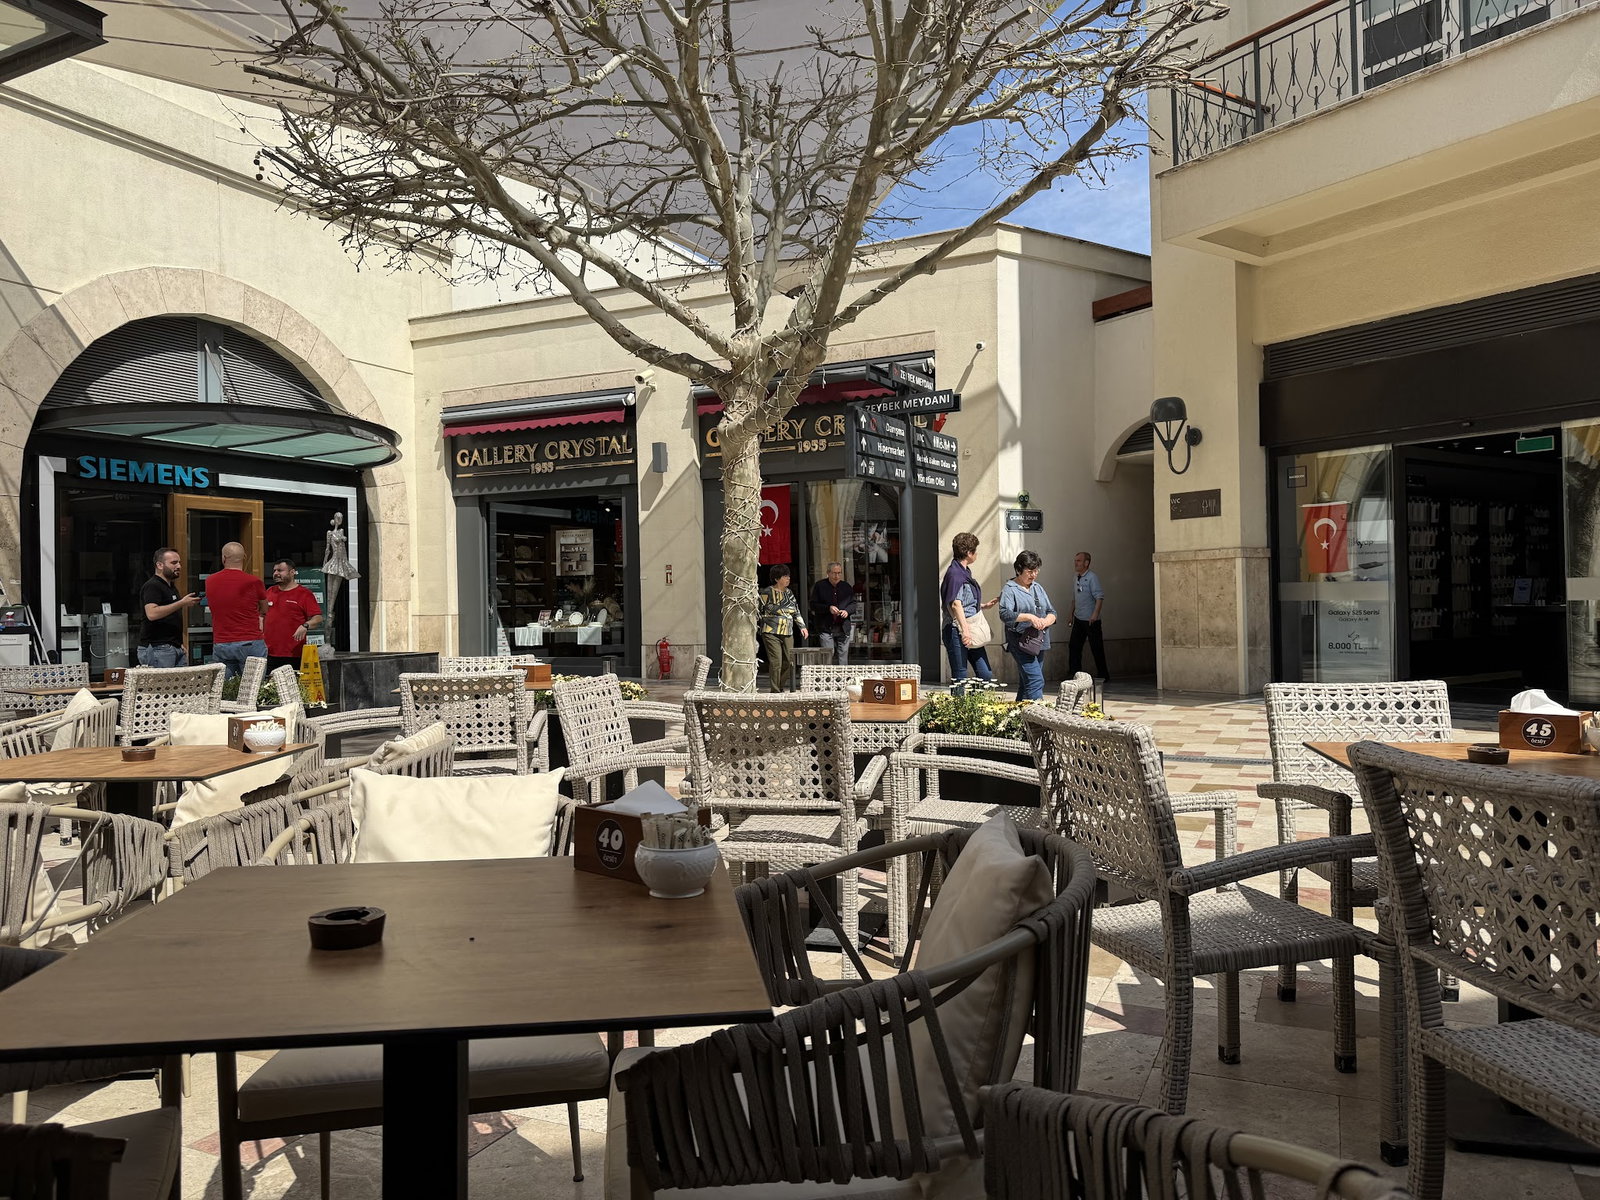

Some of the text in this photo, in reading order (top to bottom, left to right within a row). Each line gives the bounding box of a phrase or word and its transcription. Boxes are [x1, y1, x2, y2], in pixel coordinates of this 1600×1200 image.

[902, 394, 950, 409] MEYDANI
[706, 418, 807, 447] GERY
[456, 434, 633, 467] GALLERY CRYSTAL
[78, 456, 210, 488] SIEMENS
[895, 468, 906, 478] ATM
[1328, 642, 1351, 650] 8.000
[873, 685, 885, 694] 46
[1526, 723, 1552, 737] 45
[598, 827, 623, 850] 40
